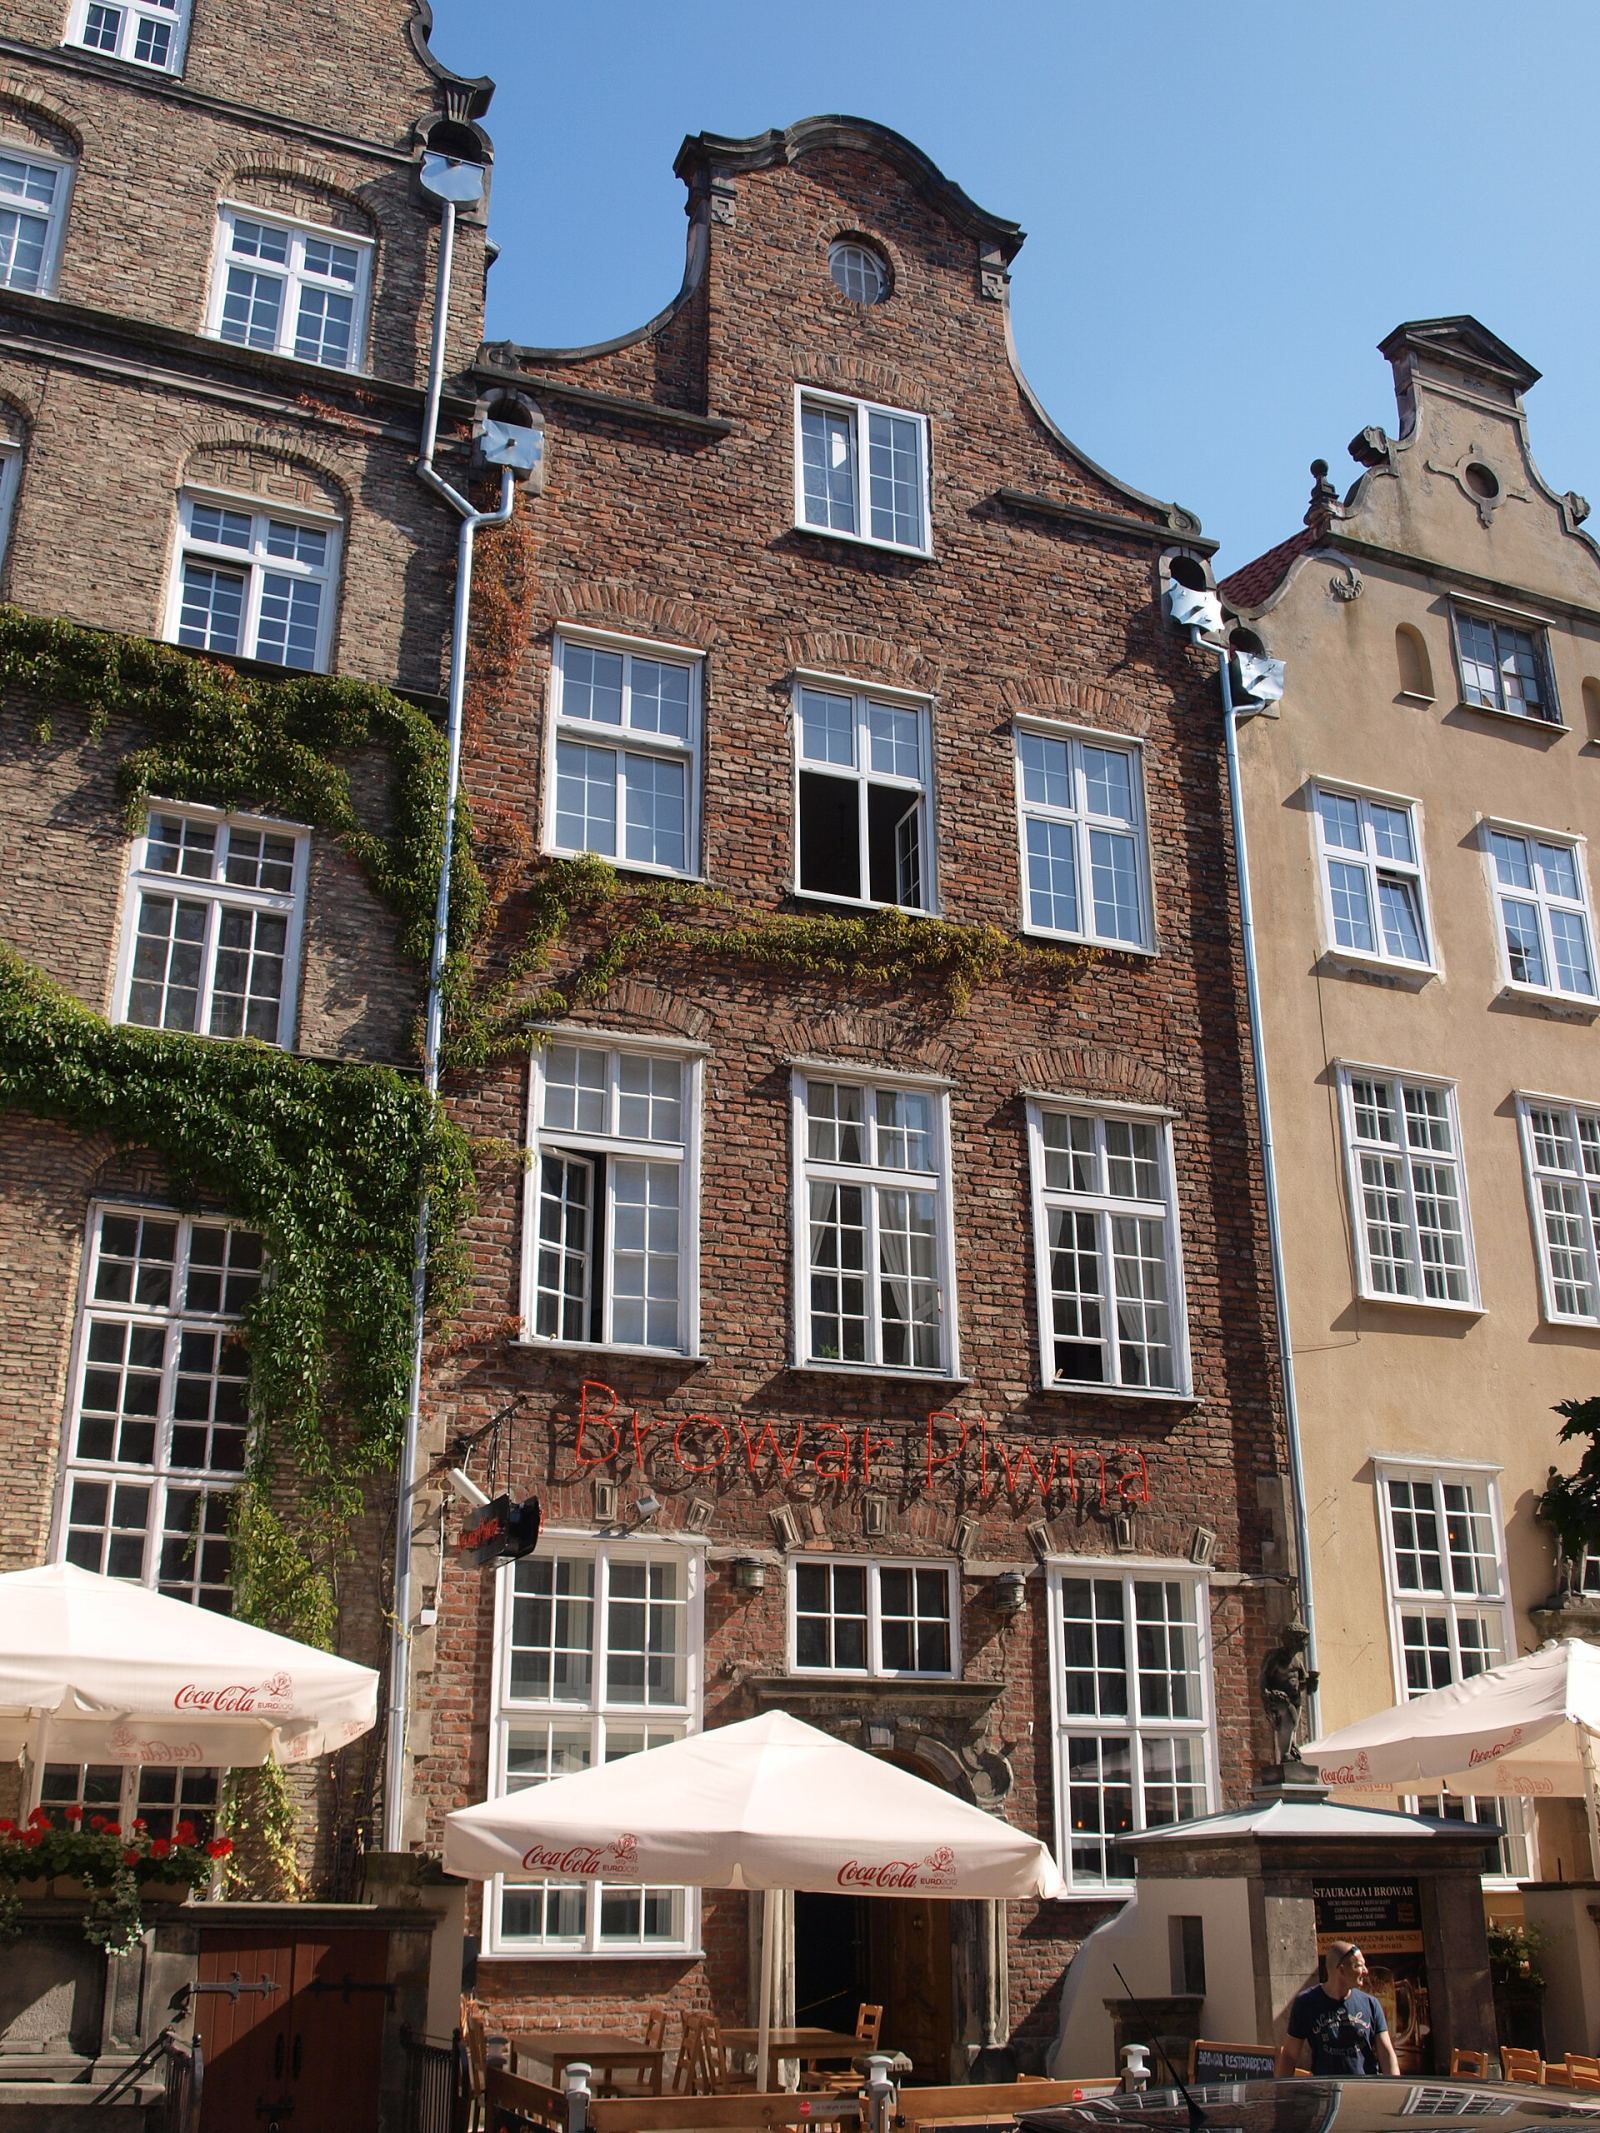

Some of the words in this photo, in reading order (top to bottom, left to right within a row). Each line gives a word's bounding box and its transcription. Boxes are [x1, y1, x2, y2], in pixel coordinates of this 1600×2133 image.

[575, 1379, 895, 1484] Browar
[926, 1411, 1149, 1505] Piwna
[174, 1683, 260, 1712] Coca-Cola
[1321, 1765, 1356, 1785] Coca-Cola
[522, 1844, 607, 1874] Coca-Cola
[837, 1860, 922, 1888] Coca-Cola
[1313, 1886, 1367, 1898] STAURACJA
[1374, 1886, 1414, 1897] BROWAR
